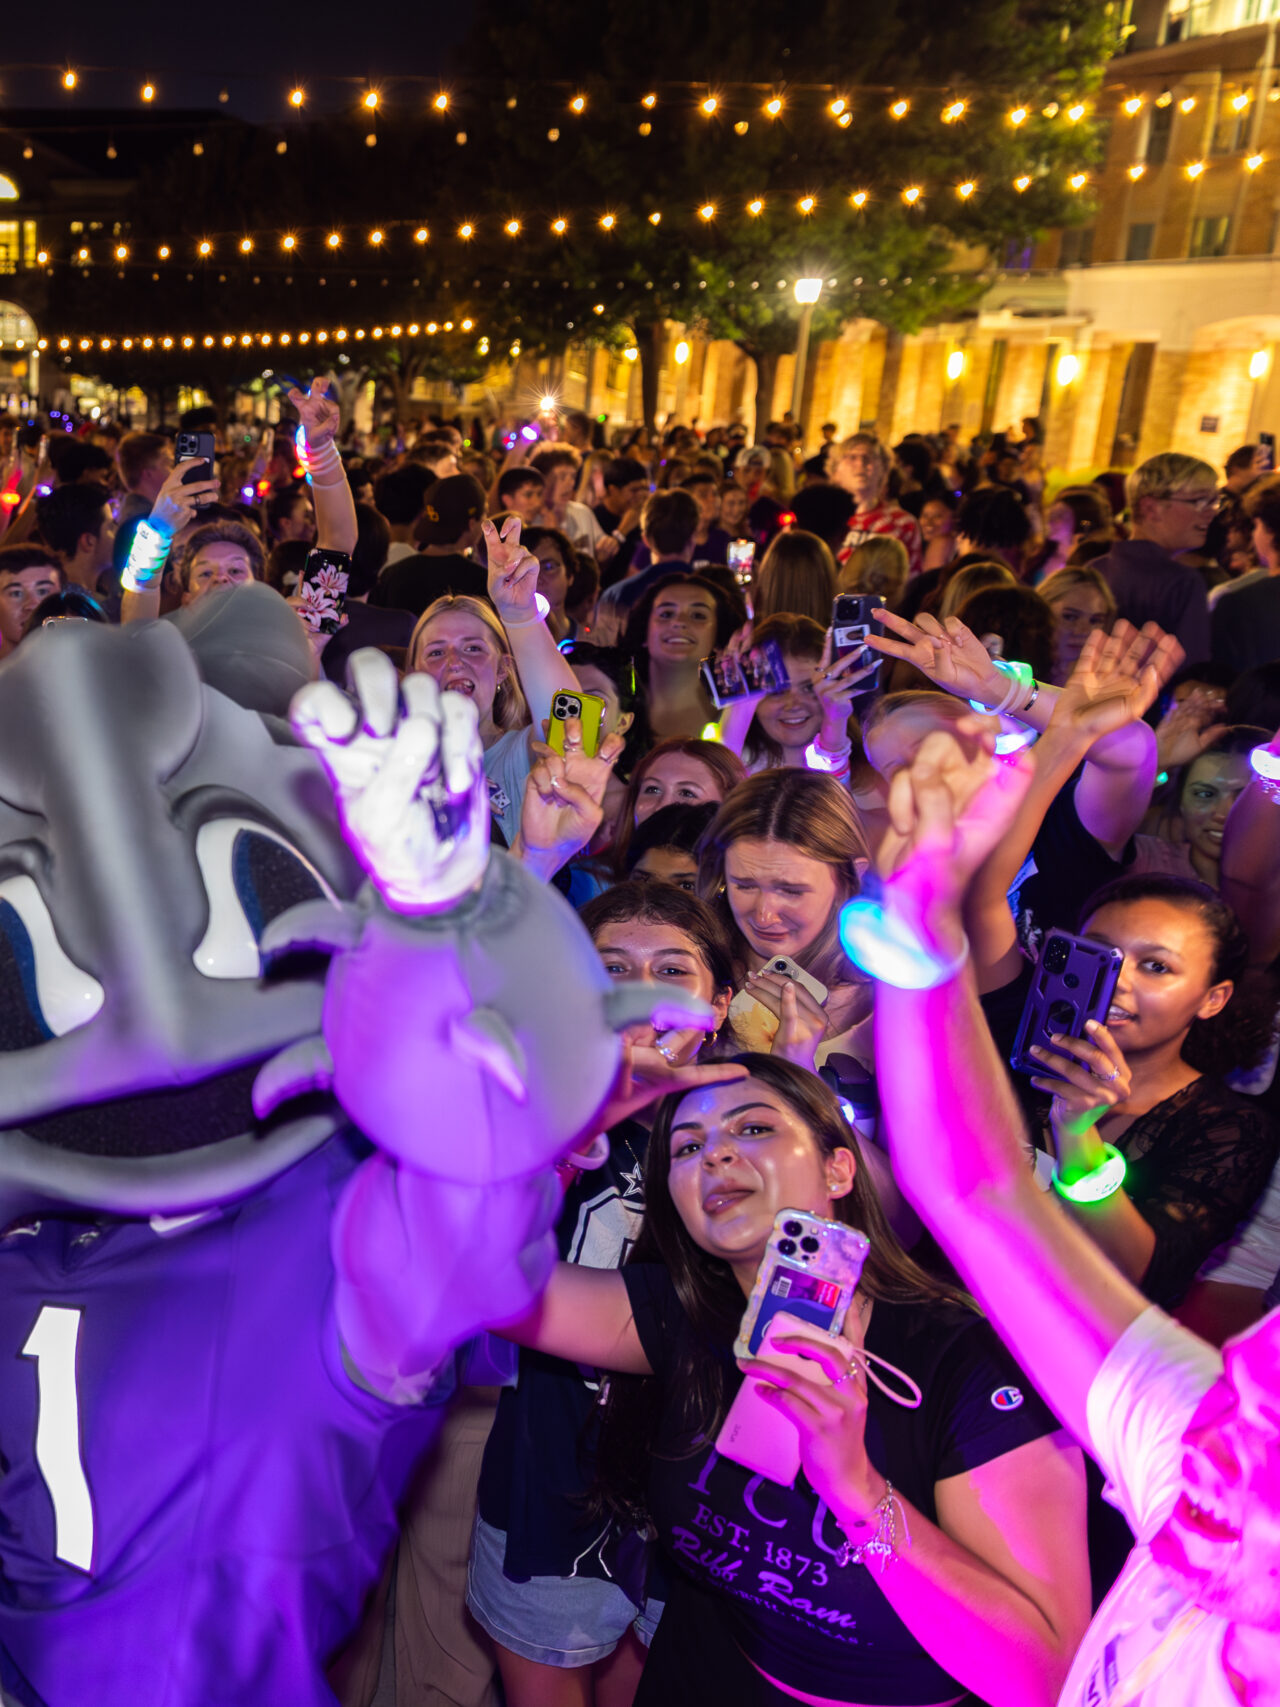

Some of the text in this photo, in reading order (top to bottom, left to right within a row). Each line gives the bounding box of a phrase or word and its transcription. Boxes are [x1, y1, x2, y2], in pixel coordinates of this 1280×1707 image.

[19, 1303, 95, 1574] 1
[691, 1503, 828, 1586] EST. 1873
[757, 1571, 857, 1629] Ram
